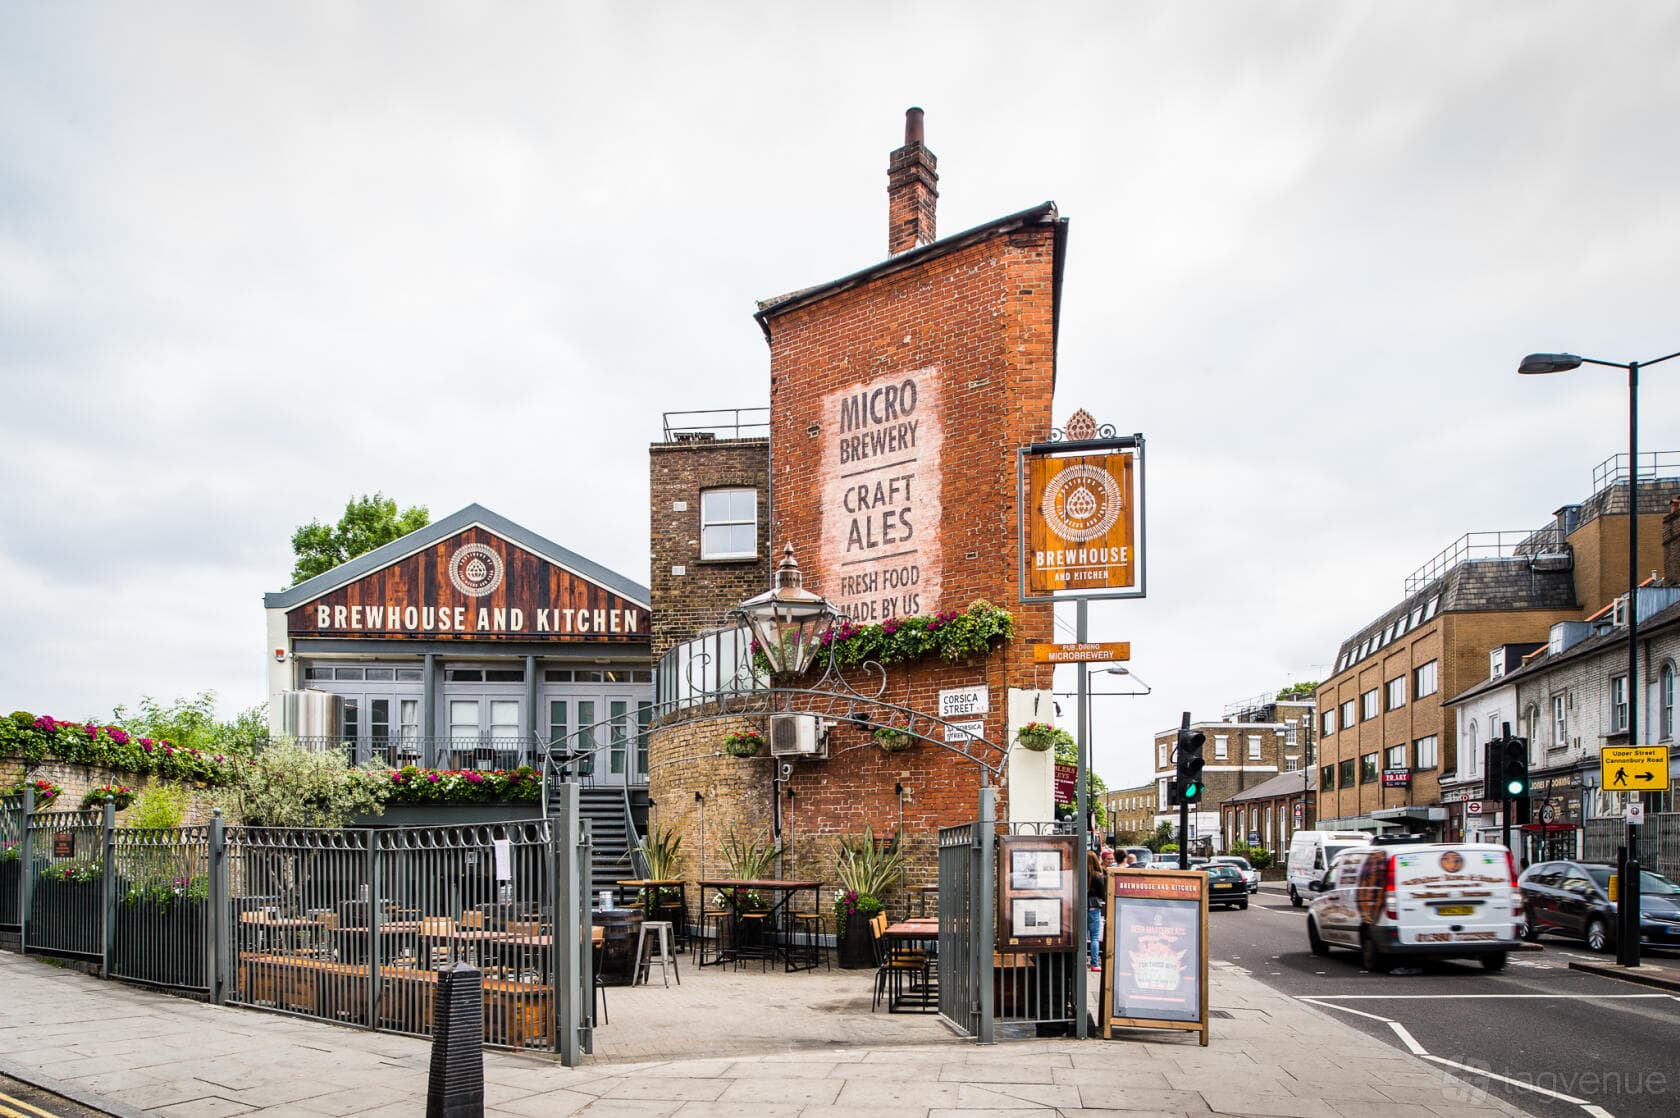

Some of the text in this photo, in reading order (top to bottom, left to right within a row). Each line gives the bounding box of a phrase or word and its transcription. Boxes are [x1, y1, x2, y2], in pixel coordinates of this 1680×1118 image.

[840, 379, 917, 434] MICRO
[840, 419, 919, 464] BREWERY
[843, 473, 915, 513] CRAFT
[846, 506, 913, 552] ALES
[1036, 547, 1128, 566] BREWHOUSE
[841, 565, 920, 597] FRESH FOOD
[1055, 570, 1109, 581] AND KITCHEN
[317, 605, 638, 633] BREWHOUSE AND KITCHEN
[882, 597, 898, 619] BY
[903, 593, 920, 615] US
[1048, 650, 1115, 661] MICROBREWERY
[944, 693, 978, 704] CORSICA
[944, 703, 975, 714] STREET
[1119, 882, 1155, 890] BREWHOUSE
